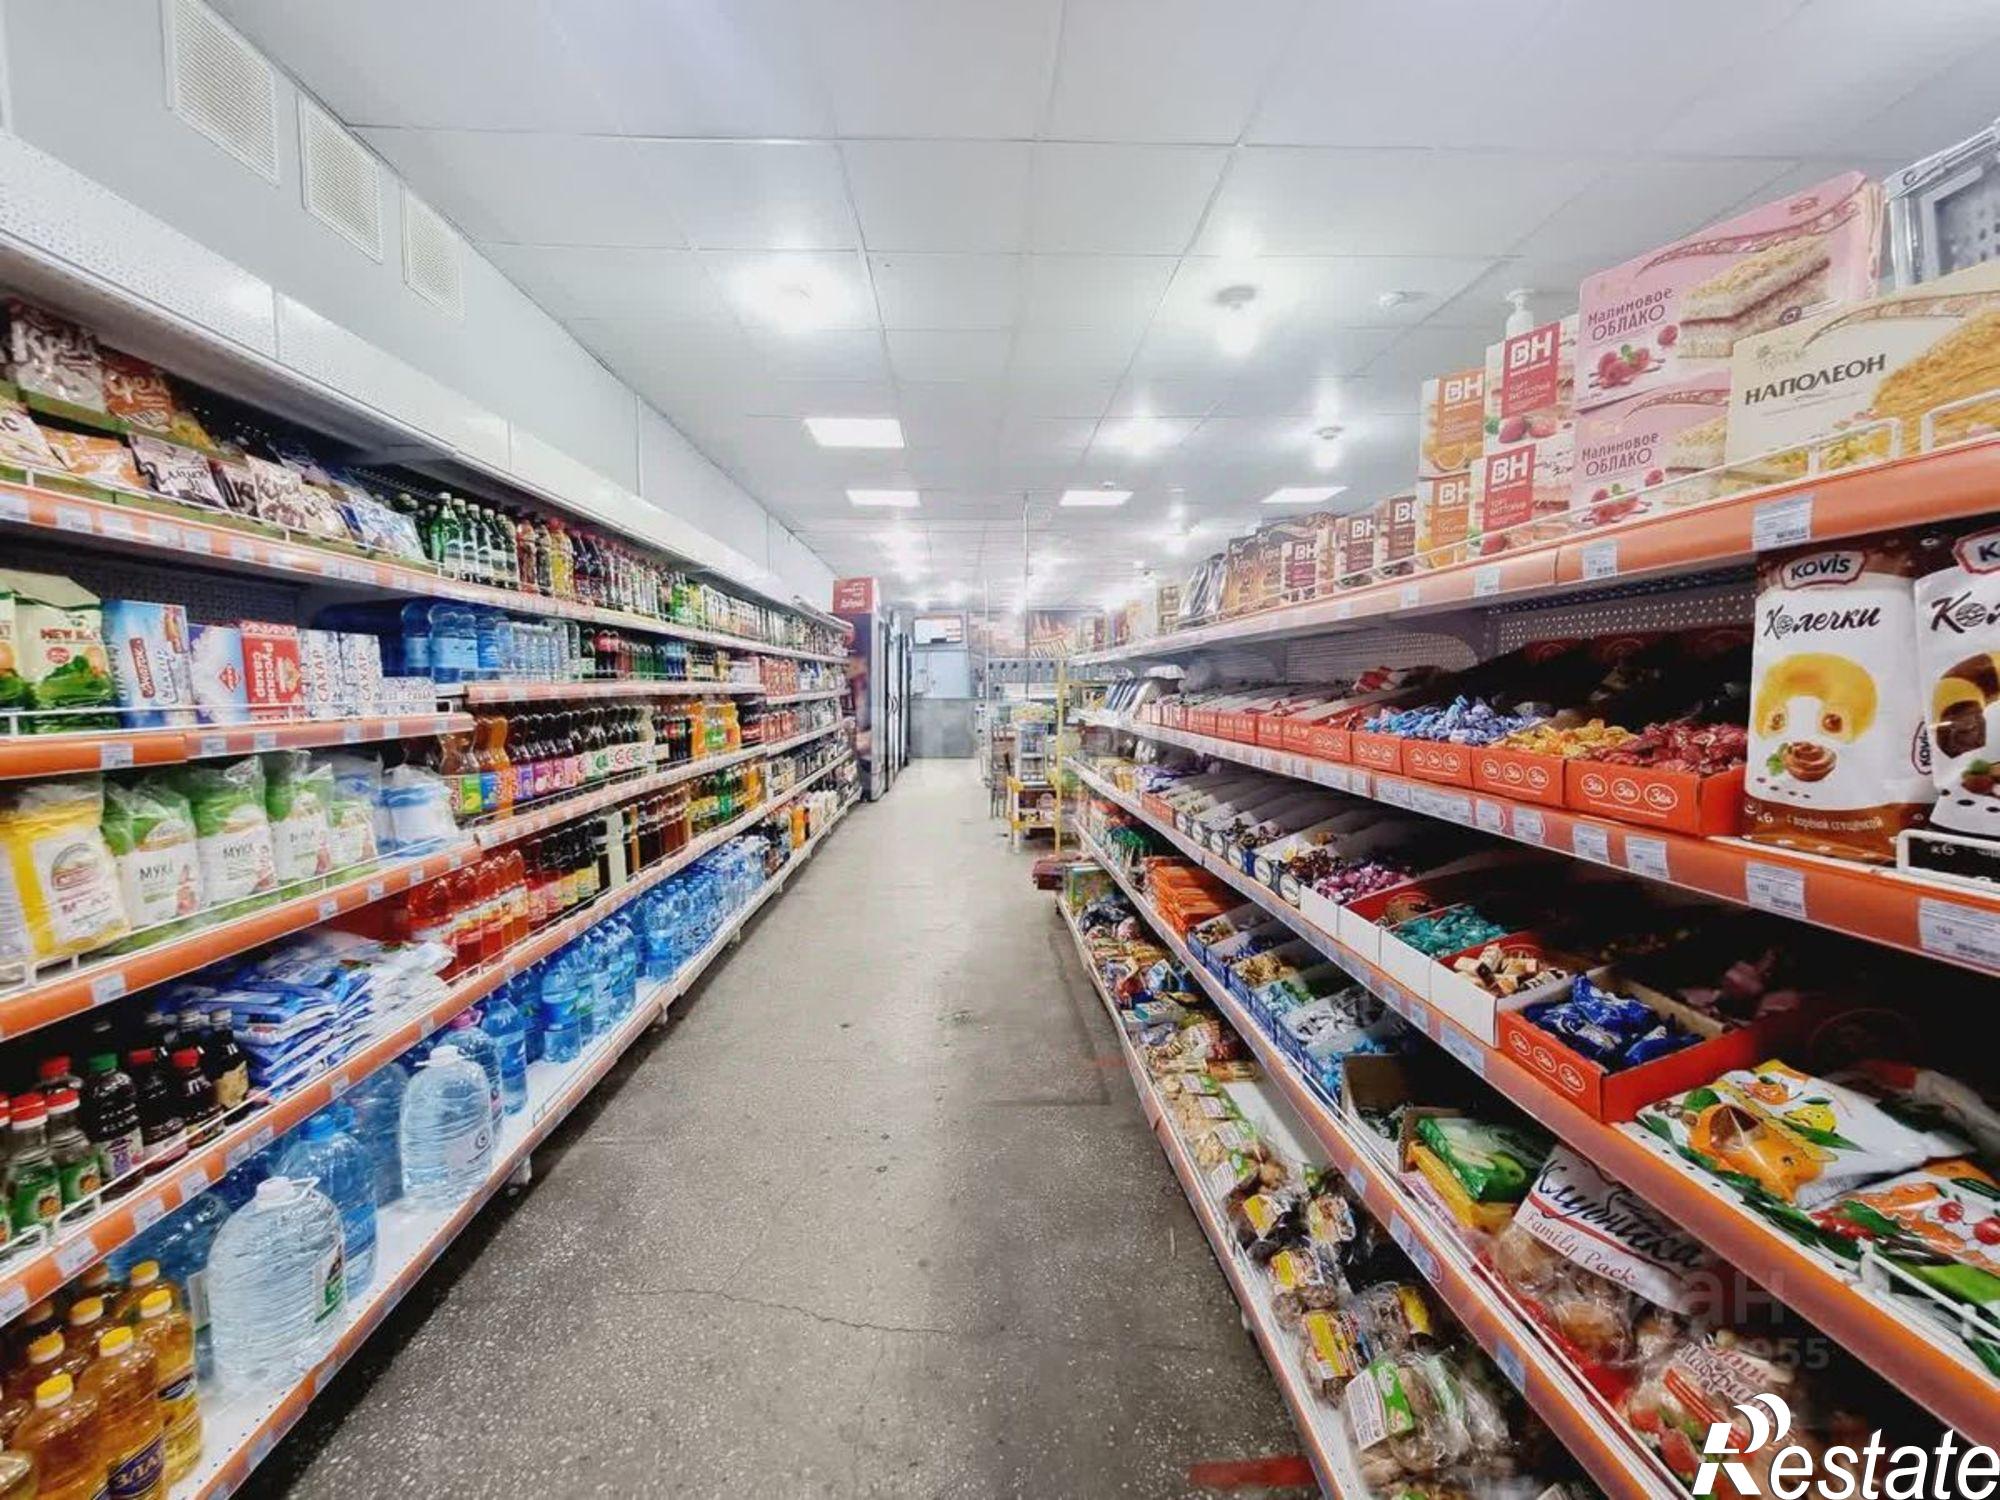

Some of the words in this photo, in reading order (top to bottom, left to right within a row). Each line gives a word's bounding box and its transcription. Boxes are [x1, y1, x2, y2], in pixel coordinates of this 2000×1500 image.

[1587, 288, 1674, 327] Малиновое
[1592, 304, 1666, 341] ОБЛАКО
[1745, 353, 1886, 405] НАПОЛЕОН
[1582, 433, 1659, 461] Малиновое
[1586, 448, 1652, 476] ОБЛАКО
[1790, 554, 1851, 580] KOVIS
[1763, 604, 1881, 640] Колечки
[1525, 1211, 1579, 1256] Family
[1583, 1251, 1637, 1283] Pack
